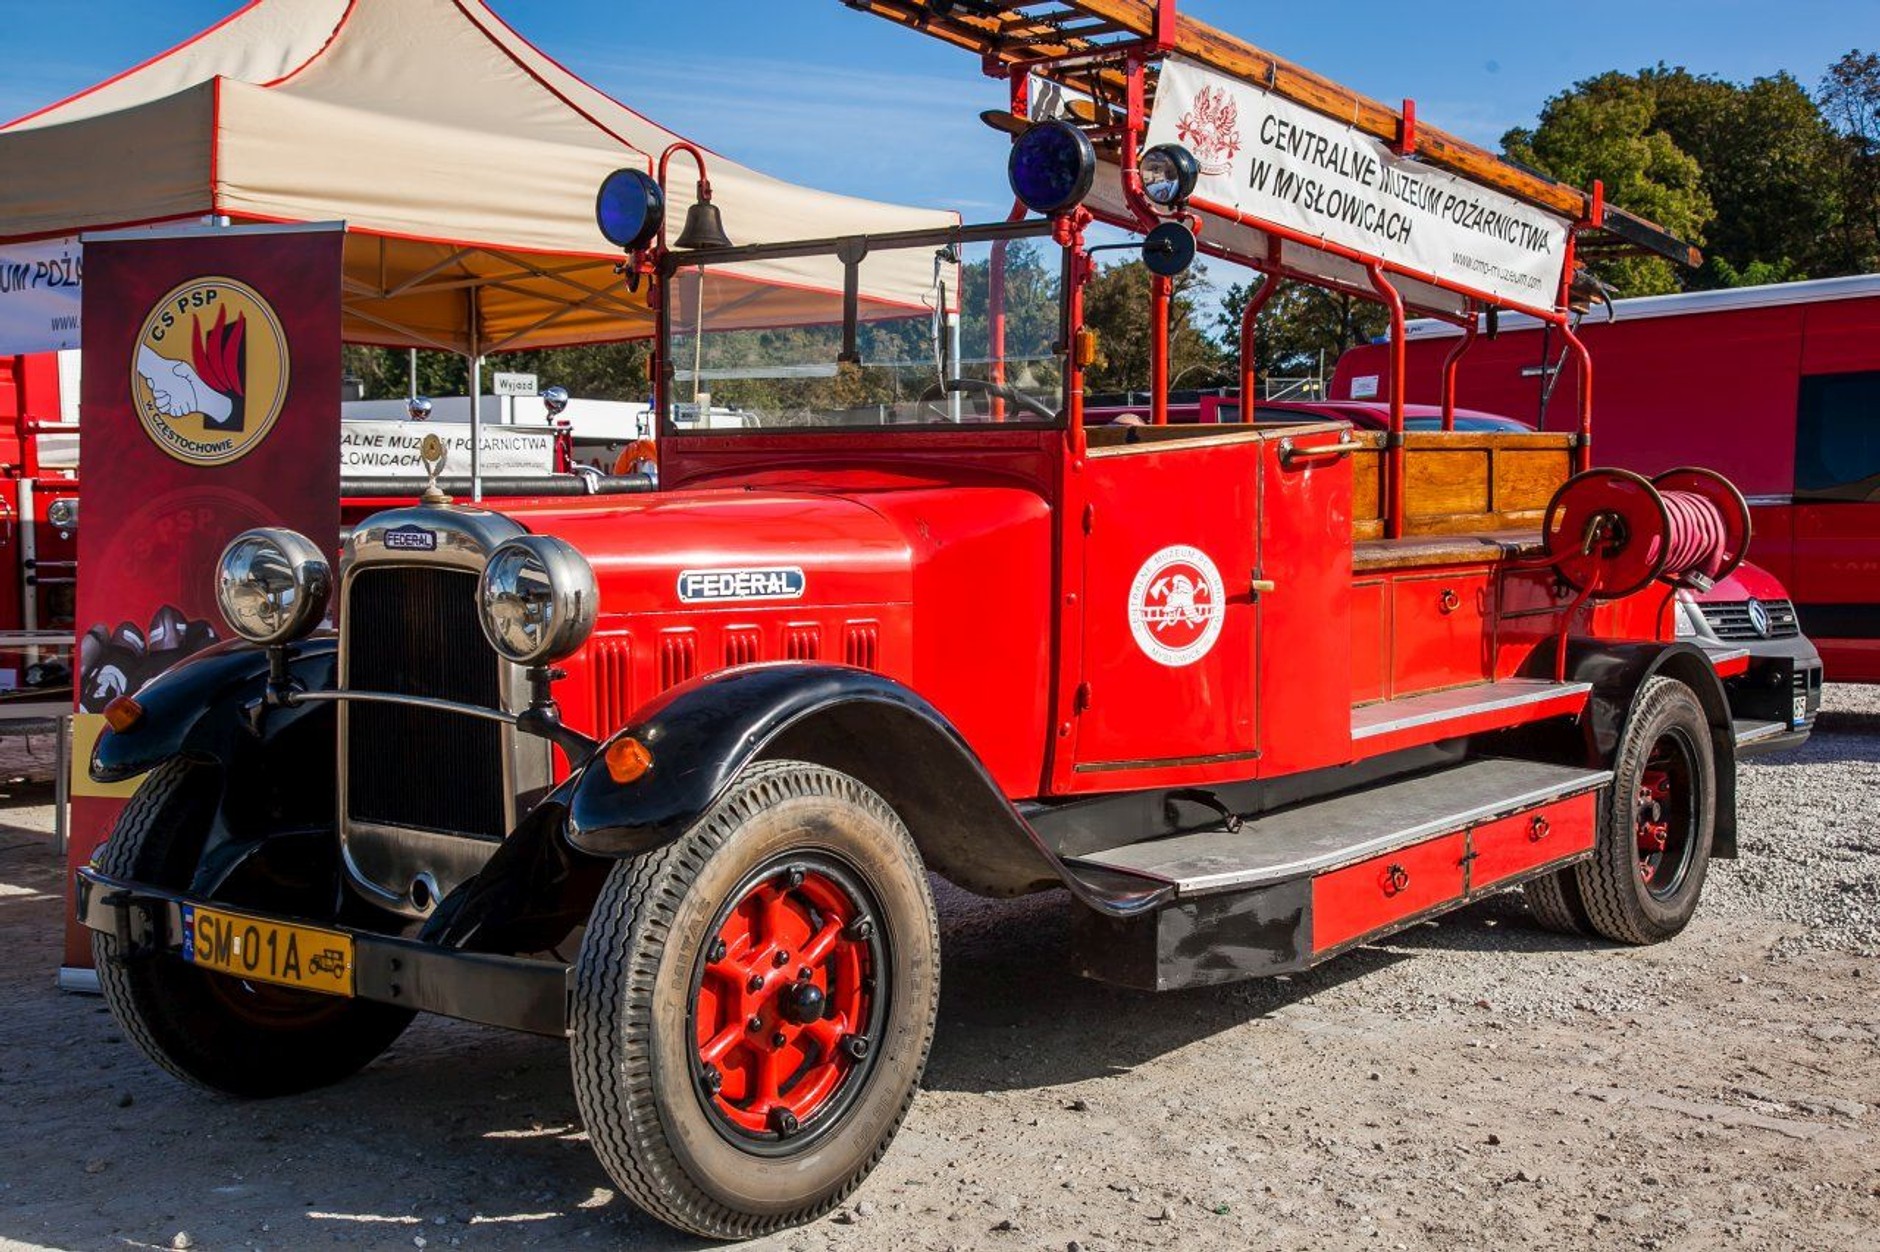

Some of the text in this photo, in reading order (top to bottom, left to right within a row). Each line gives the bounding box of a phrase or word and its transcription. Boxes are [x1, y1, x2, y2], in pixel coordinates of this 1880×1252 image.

[1249, 157, 1413, 244] W MYSŁOWICACH
[1260, 114, 1551, 255] CENTRALNE MUZEUM POŻARNICTWA
[1452, 251, 1542, 291] www.cmp-muzeum.com
[151, 289, 218, 342] CS PSP
[500, 379, 533, 392] Wyjazd
[152, 411, 233, 453] CZĘSTOCHOWIE
[341, 434, 547, 451] ALNE MUZM POARNICTWA
[386, 531, 433, 547] FEDERAL
[686, 572, 797, 598] FEDERAL
[197, 914, 302, 980] SM 01A
